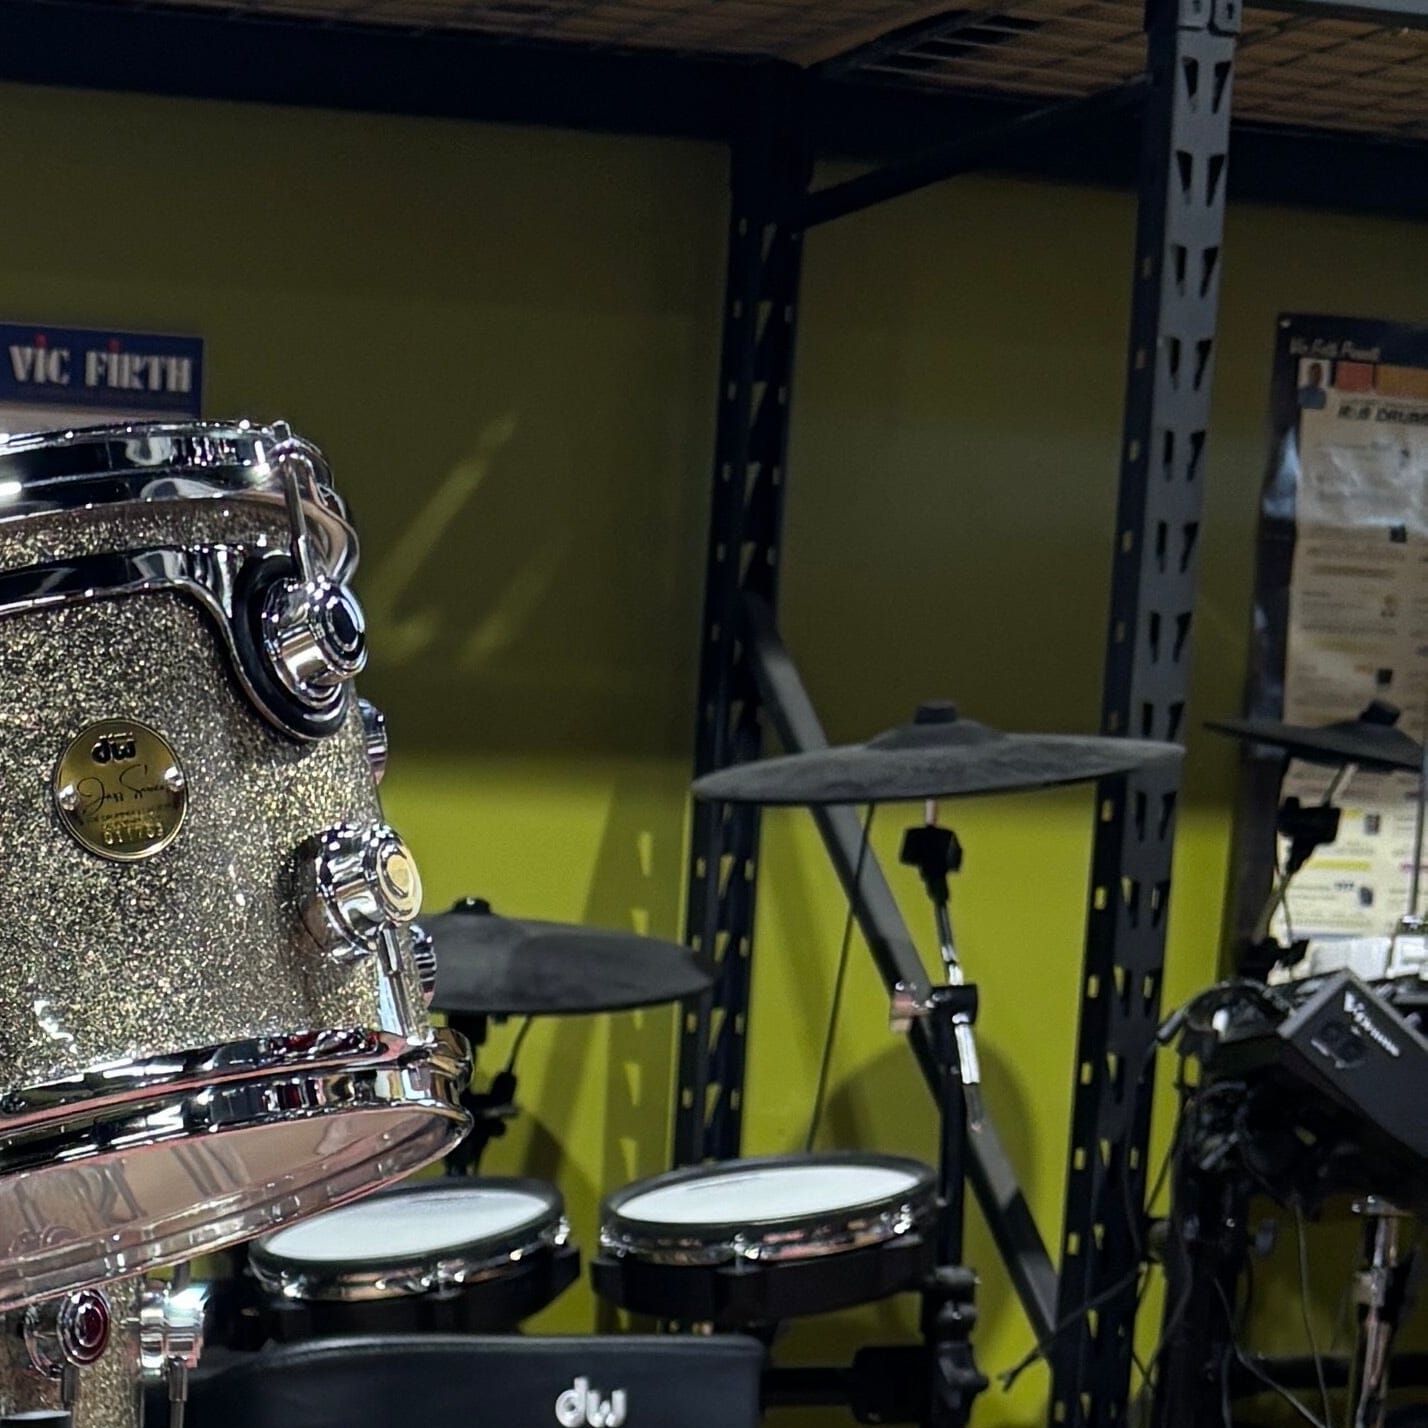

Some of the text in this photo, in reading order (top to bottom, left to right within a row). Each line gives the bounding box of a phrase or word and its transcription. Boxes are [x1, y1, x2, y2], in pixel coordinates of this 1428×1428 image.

[8, 334, 193, 394] VIC FIRTH
[555, 1376, 628, 1428] dw
